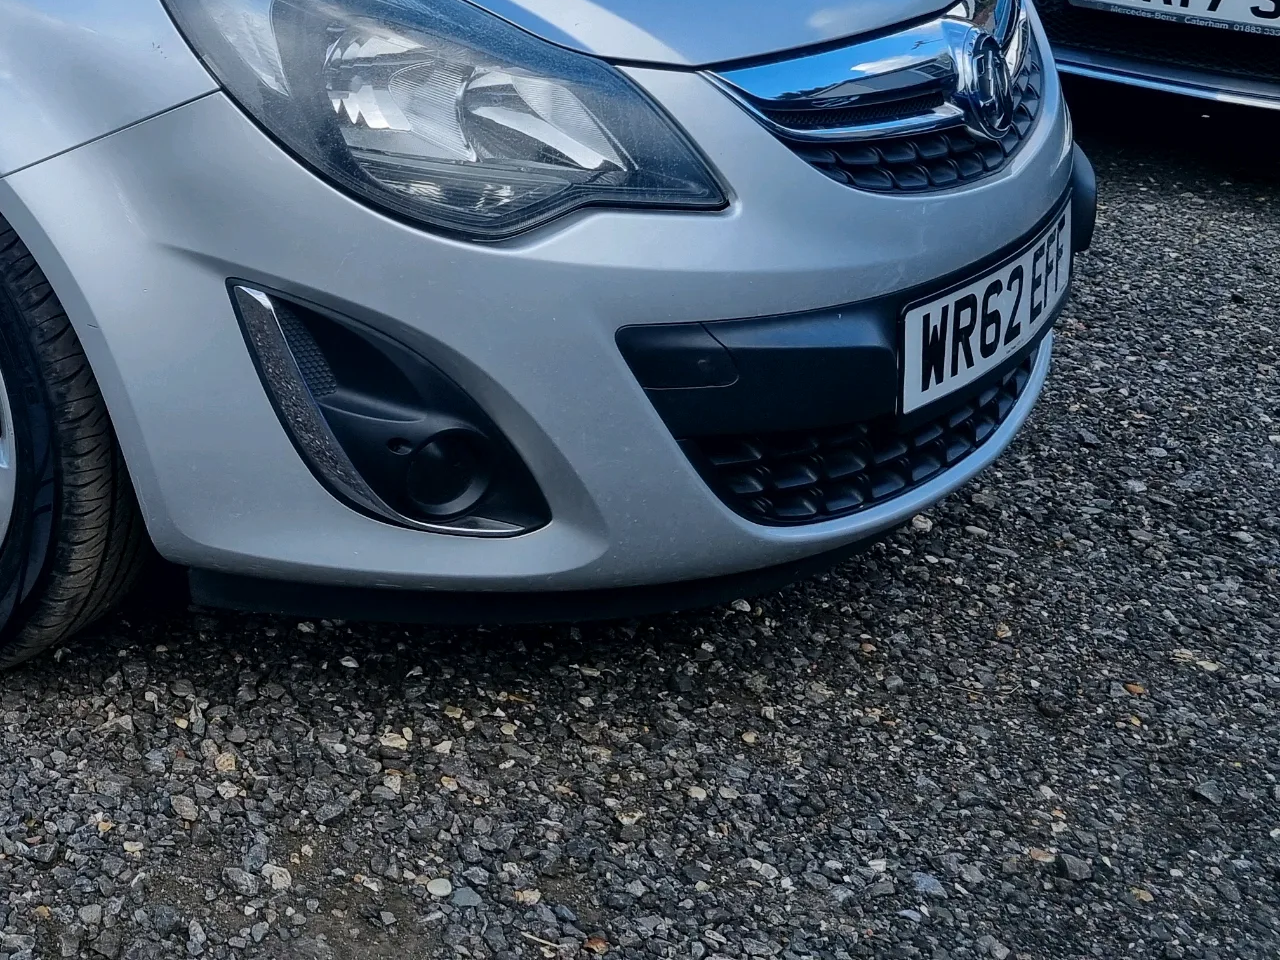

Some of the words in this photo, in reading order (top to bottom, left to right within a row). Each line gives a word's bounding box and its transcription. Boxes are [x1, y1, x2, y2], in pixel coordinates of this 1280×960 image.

[1110, 5, 1178, 22] Mercedes-Benz
[1184, 16, 1229, 30] Caterham
[1233, 24, 1262, 35] 01883
[1263, 27, 1280, 37] 333
[921, 264, 1024, 393] WR62
